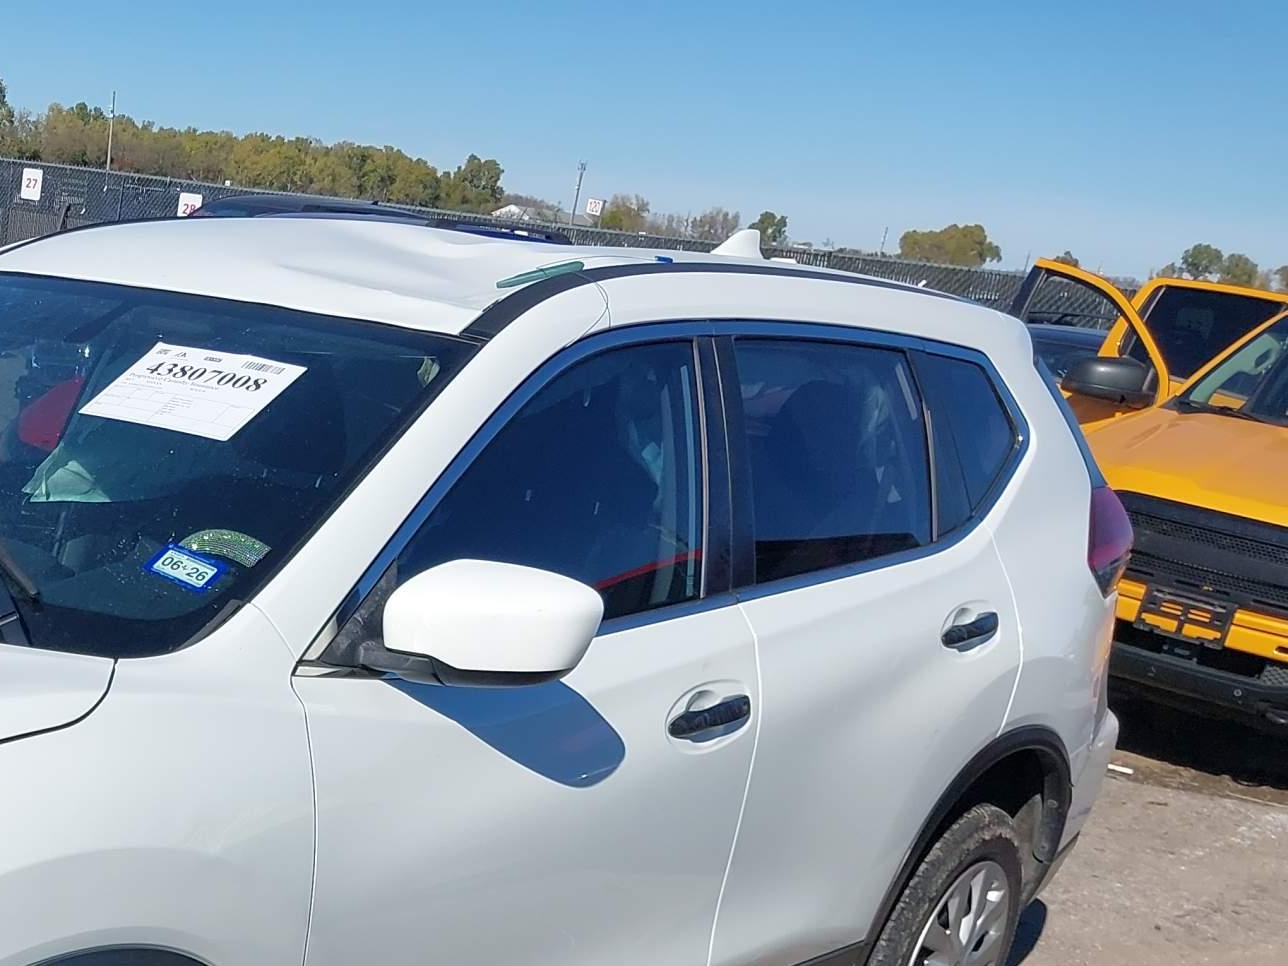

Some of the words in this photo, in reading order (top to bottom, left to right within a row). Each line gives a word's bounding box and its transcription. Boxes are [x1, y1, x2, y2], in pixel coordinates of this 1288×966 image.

[26, 178, 38, 189] 27
[182, 203, 197, 215] 28
[146, 361, 267, 391] 43807008
[161, 557, 184, 570] 06
[186, 567, 208, 581] 26
